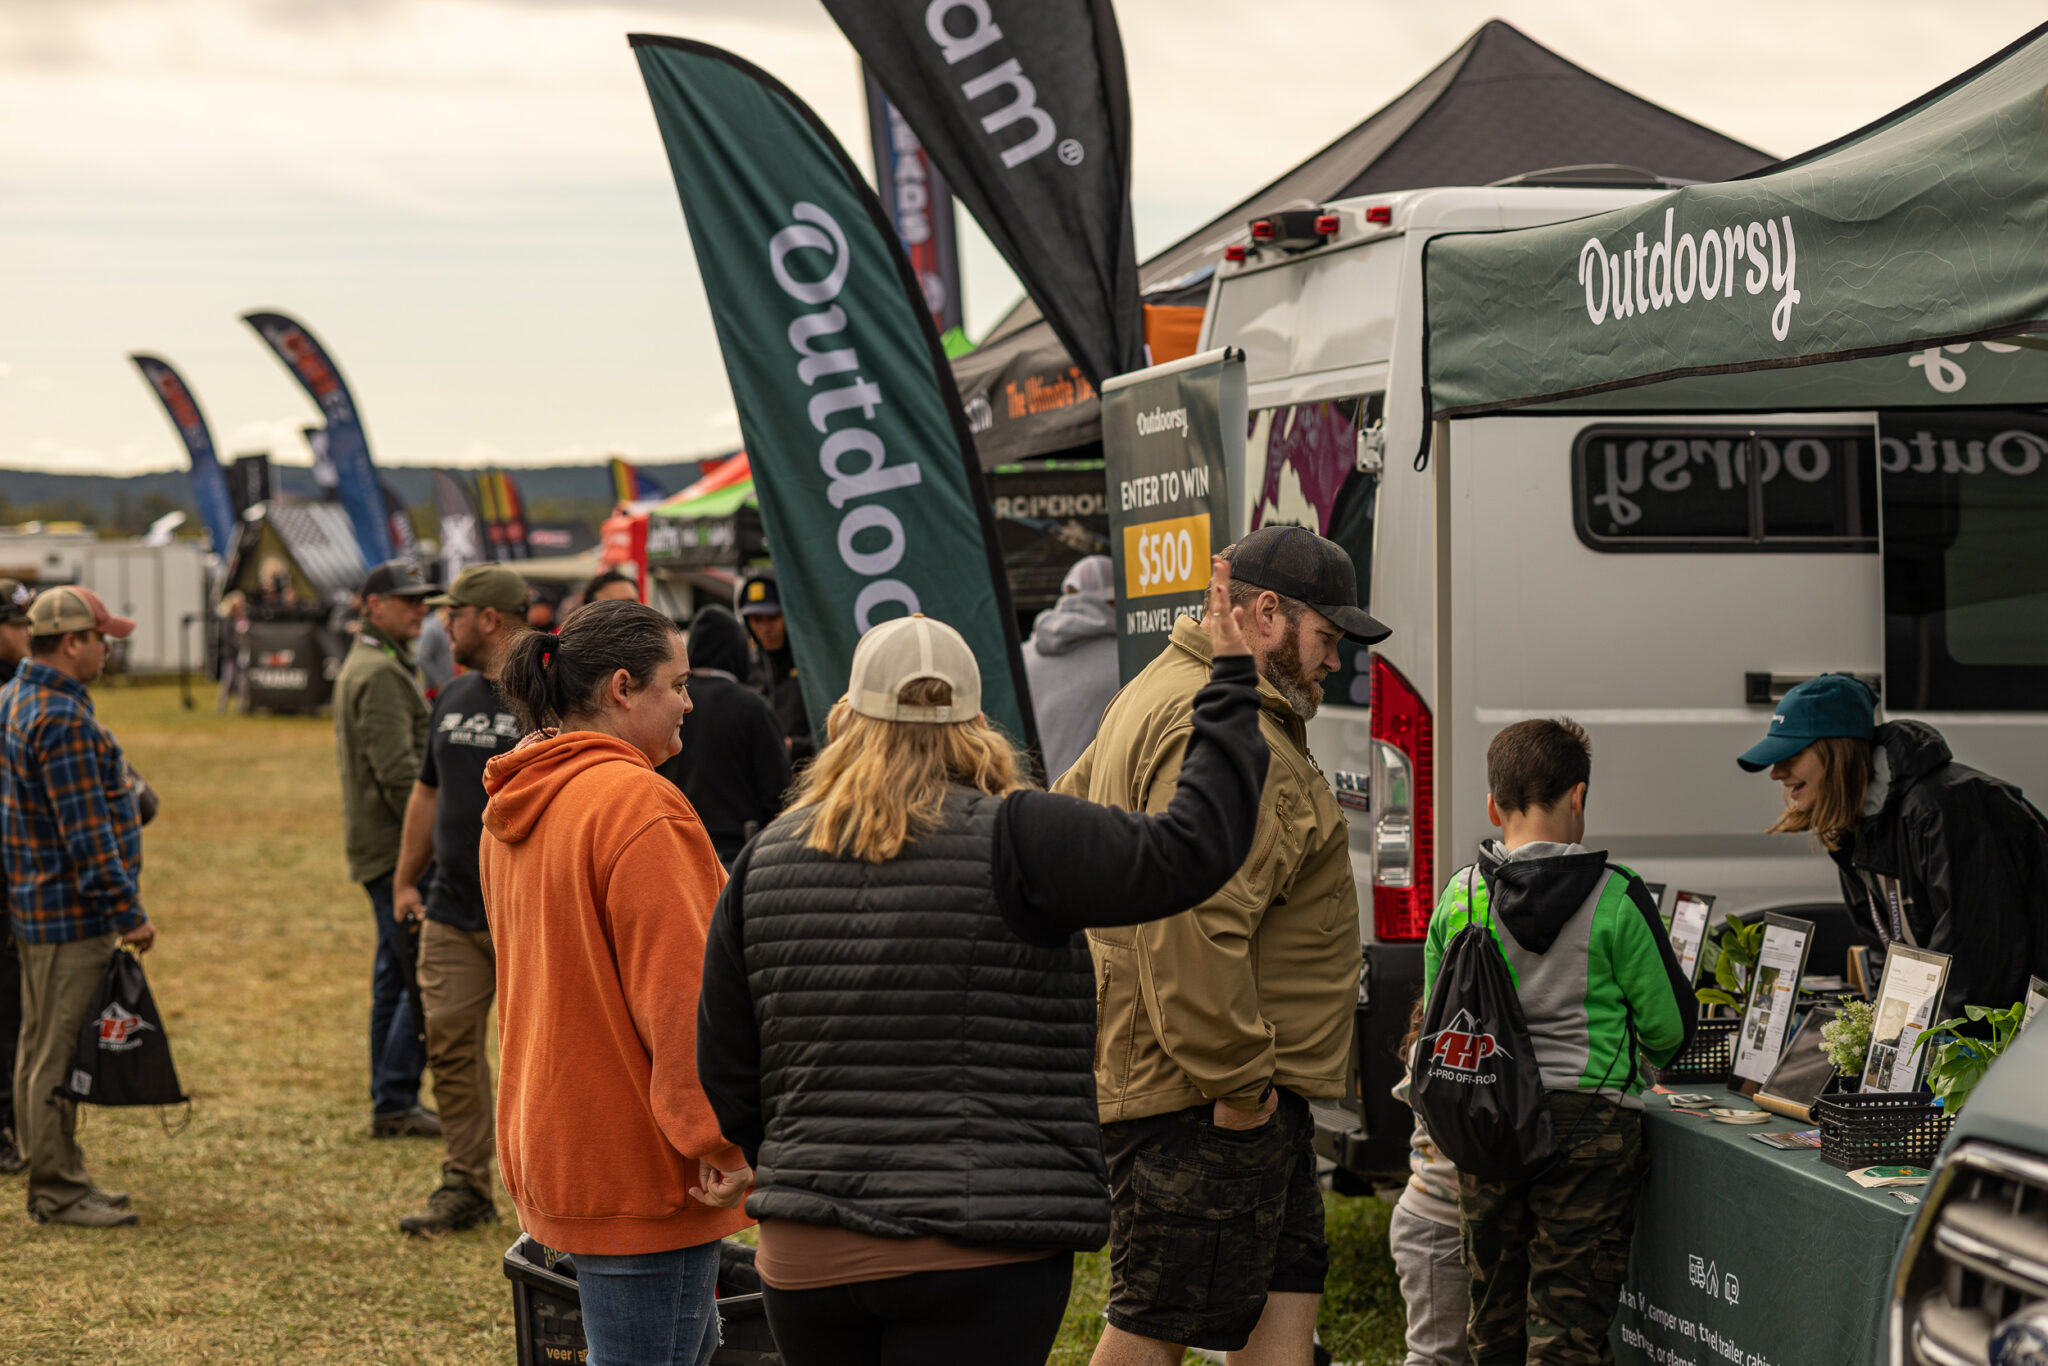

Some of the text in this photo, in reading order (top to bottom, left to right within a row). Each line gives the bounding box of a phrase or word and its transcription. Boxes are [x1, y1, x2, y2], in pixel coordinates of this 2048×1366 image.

[1579, 207, 1801, 342] Outdoorsy
[1136, 406, 1188, 438] Outdoorsy
[1121, 465, 1210, 512] ENTER TO WIN
[1138, 527, 1193, 594] $500
[1136, 608, 1174, 635] TRAVEL
[1648, 1304, 1678, 1332] camper
[1678, 1318, 1698, 1343] van,
[546, 1347, 573, 1361] veer
[1656, 1346, 1667, 1363] or
